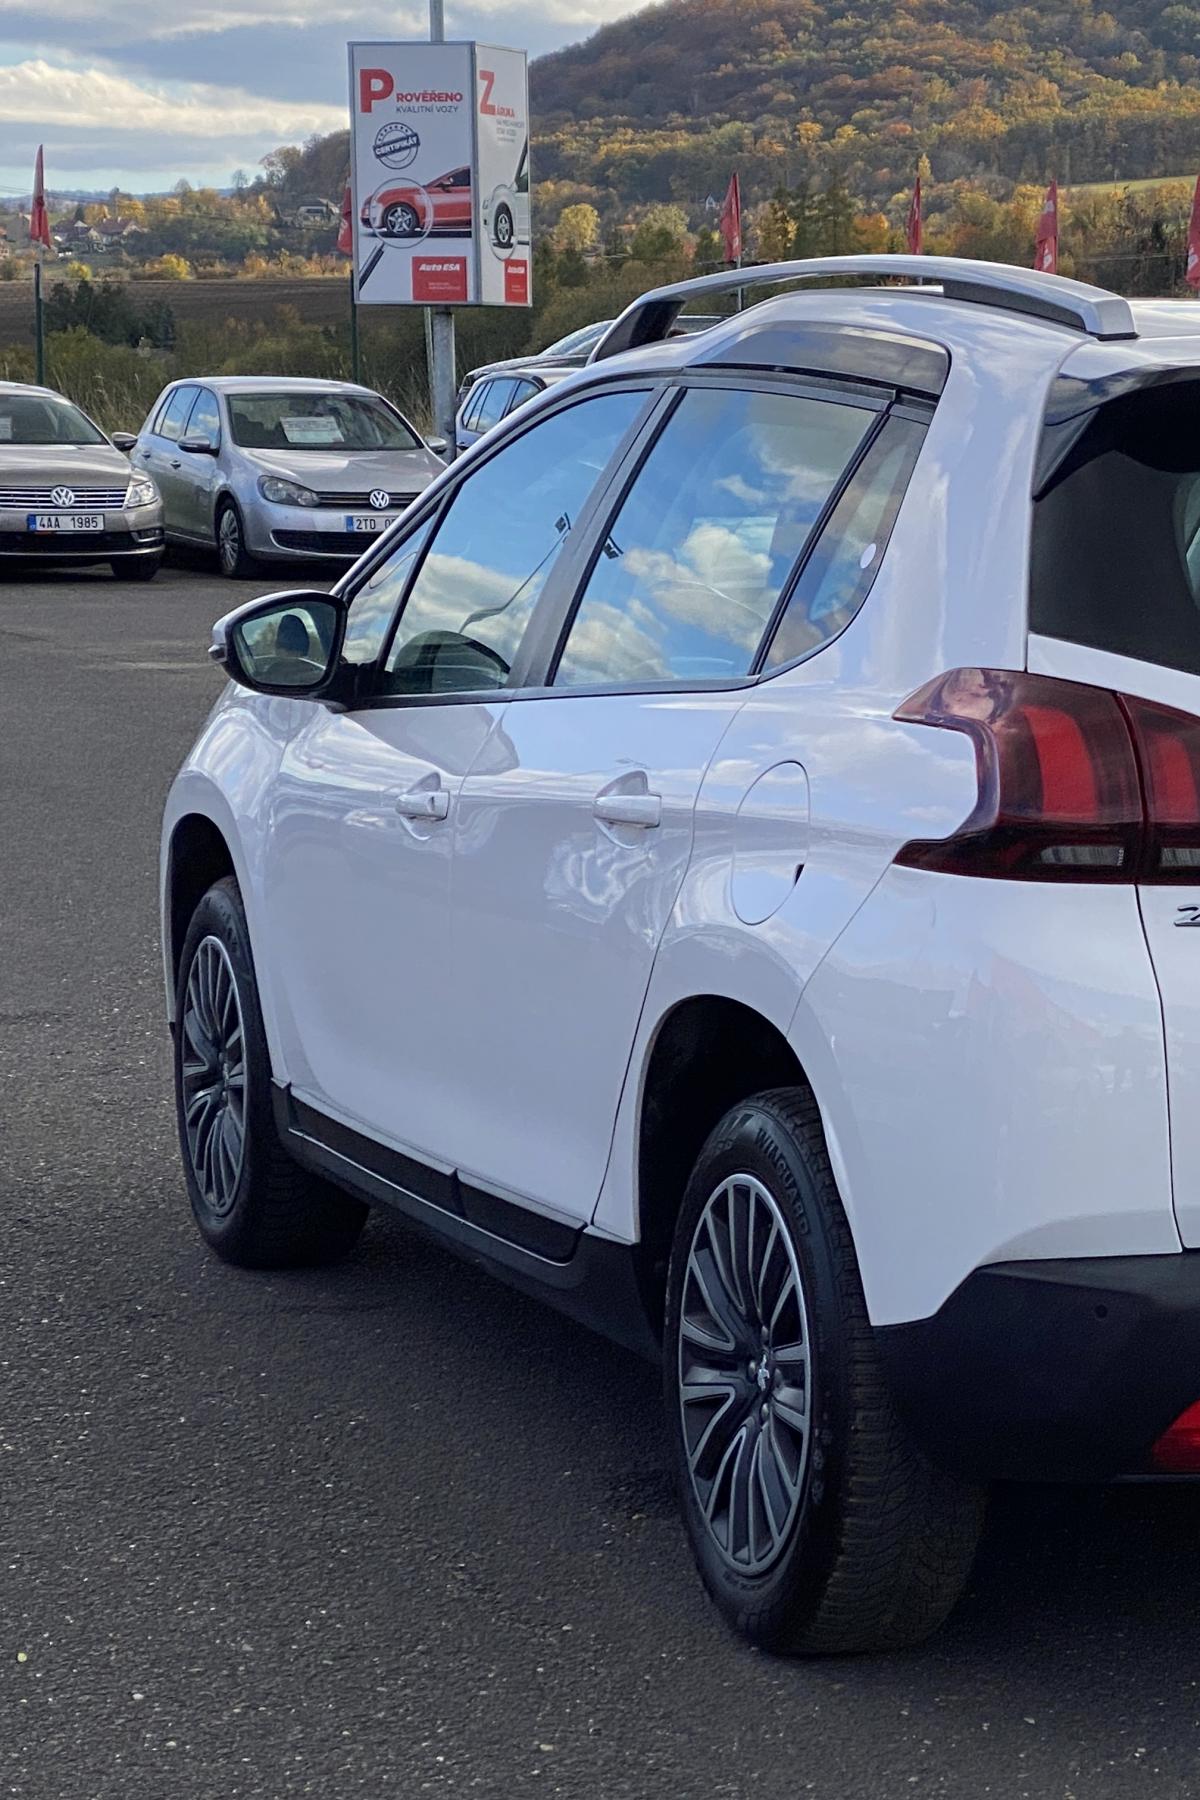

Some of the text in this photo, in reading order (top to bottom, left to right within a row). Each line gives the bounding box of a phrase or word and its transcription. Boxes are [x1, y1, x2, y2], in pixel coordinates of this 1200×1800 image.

[396, 105, 458, 114] KVALITNÍ VOZY
[419, 263, 460, 272] Auto ESA
[39, 516, 98, 529] 4AA 1985
